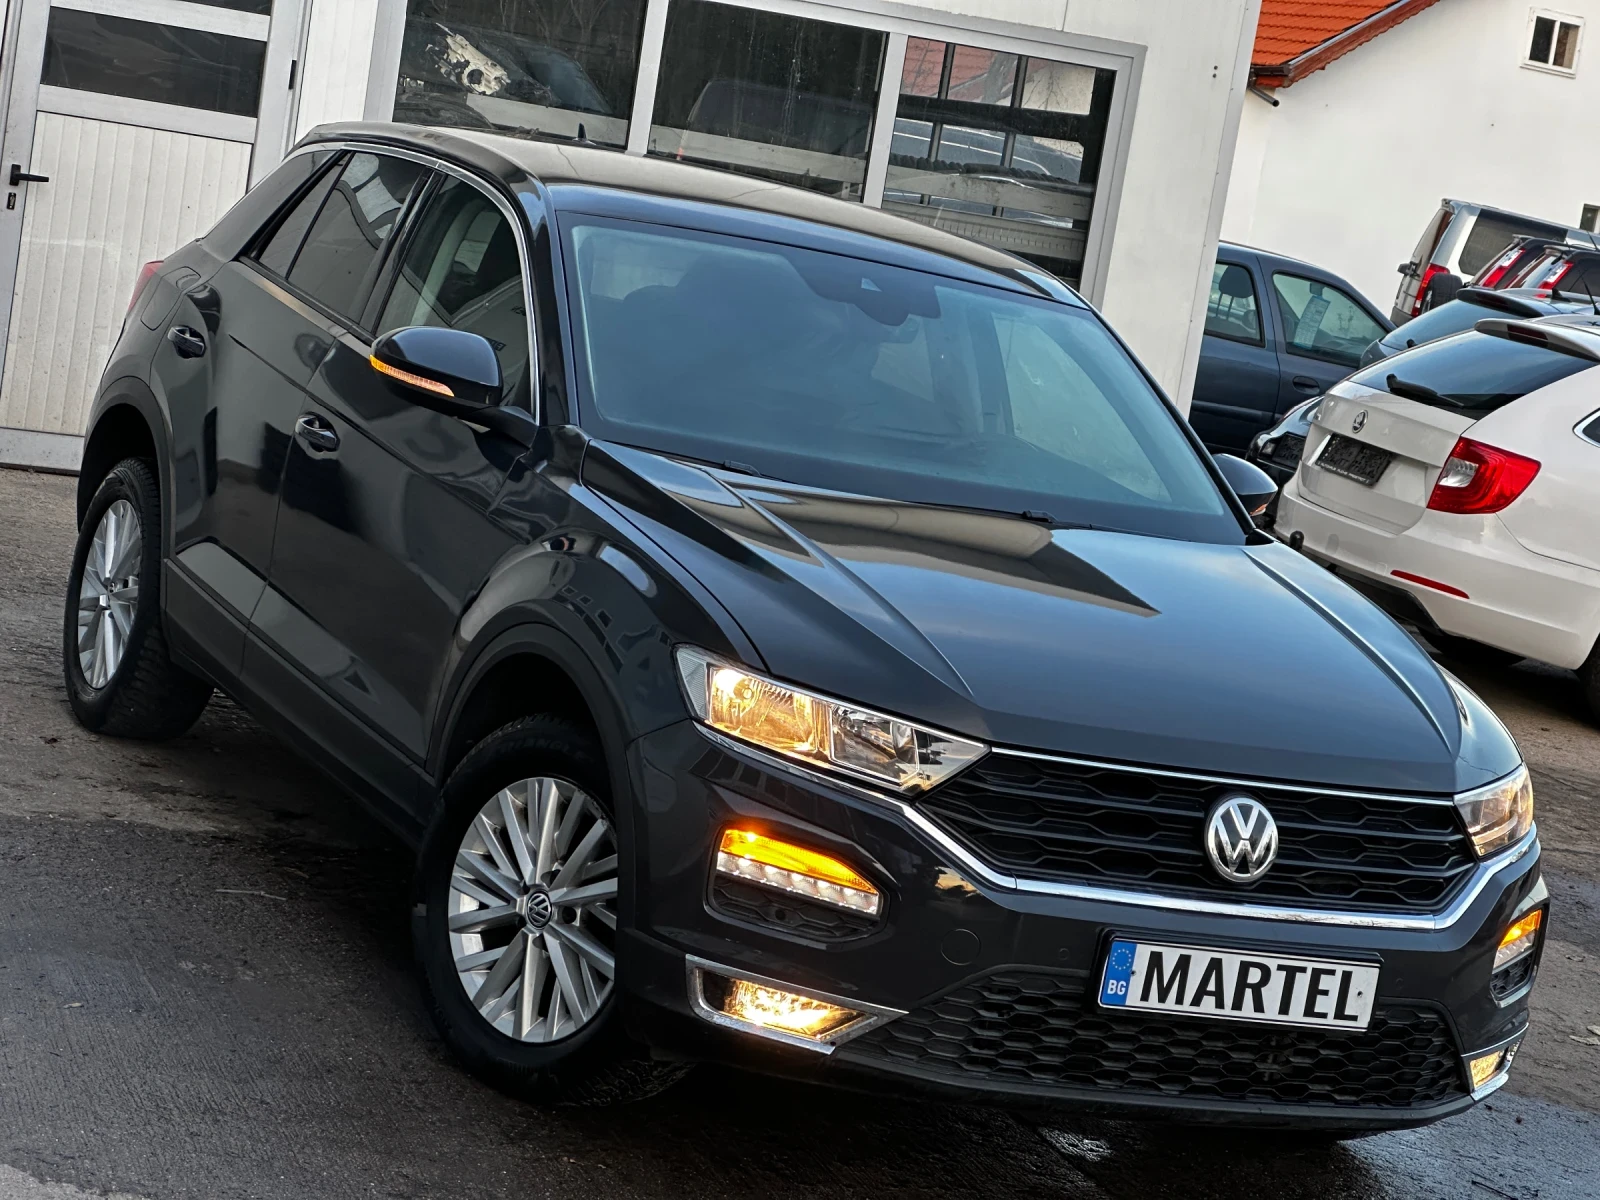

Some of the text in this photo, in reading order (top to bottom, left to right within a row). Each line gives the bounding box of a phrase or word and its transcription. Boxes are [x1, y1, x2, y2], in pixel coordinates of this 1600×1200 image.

[1207, 797, 1278, 882] VW
[1107, 979, 1127, 995] BG
[1139, 950, 1359, 1022] MARTEL
